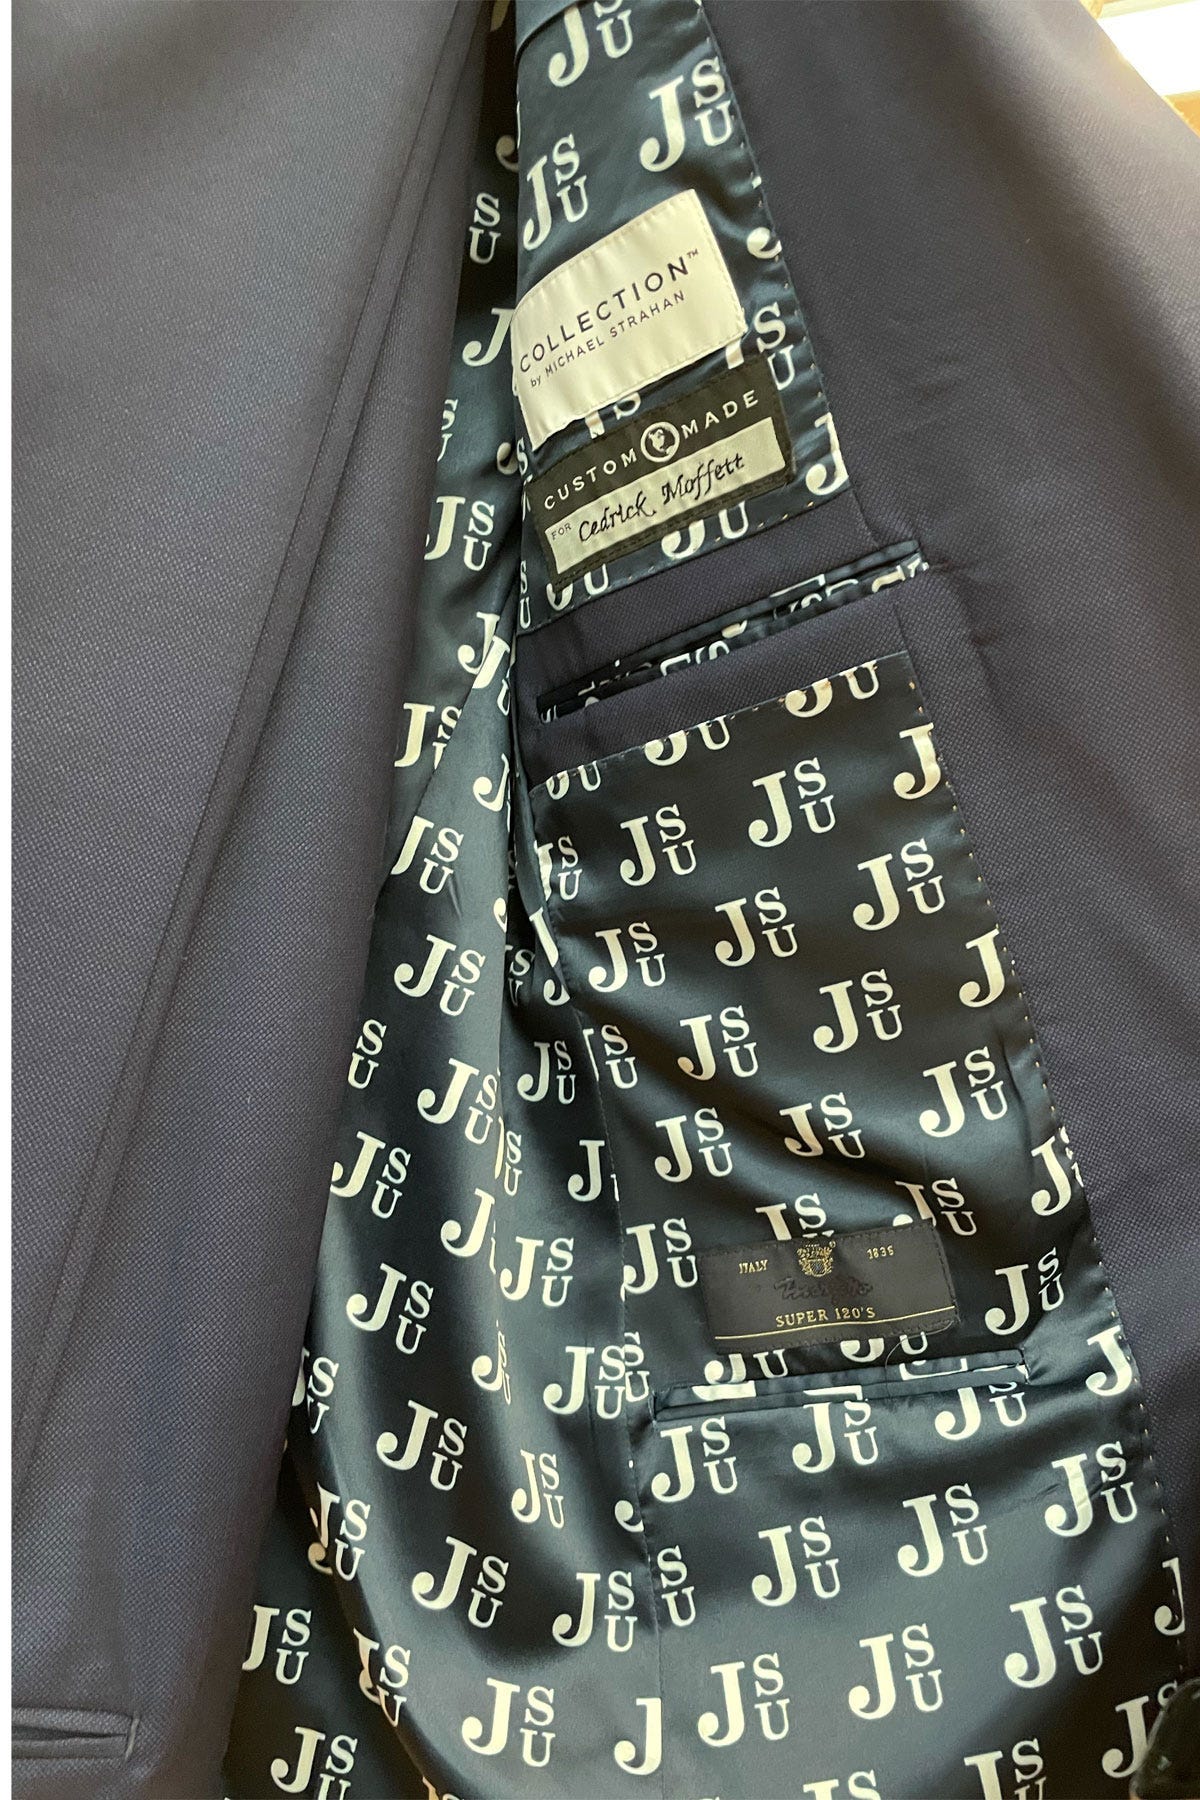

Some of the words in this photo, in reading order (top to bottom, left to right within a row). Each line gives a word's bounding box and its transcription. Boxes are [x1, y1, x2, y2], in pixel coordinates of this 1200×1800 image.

[531, 375, 543, 387] by
[545, 335, 605, 376] MICHAEL
[609, 290, 686, 338] STRAHAN
[544, 447, 637, 510] CUSTOM
[681, 389, 759, 440] MADE
[551, 522, 572, 541] FOR
[738, 1259, 769, 1275] ITALY
[775, 1308, 829, 1328] SUPER
[834, 1306, 876, 1321] 120'S
